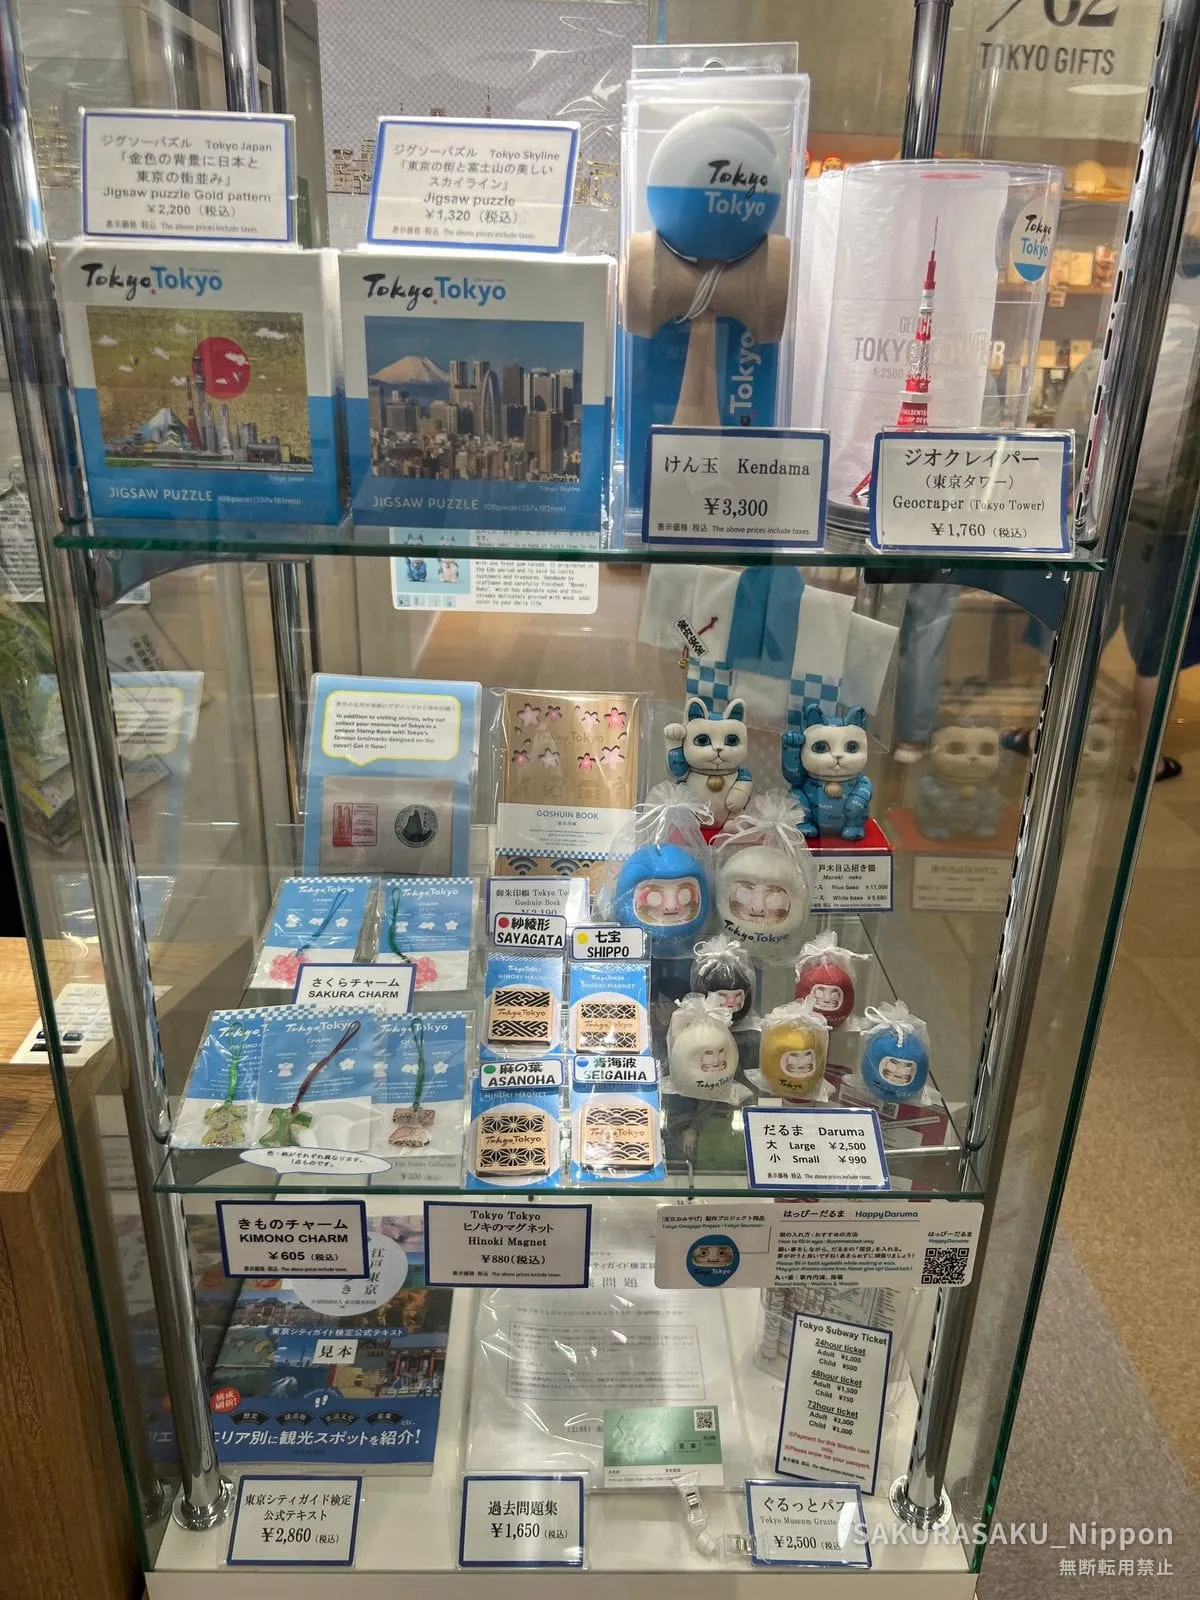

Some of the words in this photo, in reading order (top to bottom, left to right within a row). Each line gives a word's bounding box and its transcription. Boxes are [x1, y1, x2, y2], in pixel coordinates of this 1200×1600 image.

[980, 42, 1048, 71] TOKYO
[1054, 48, 1115, 75] GIFTS
[102, 134, 192, 150] ジグソーパズル
[206, 140, 237, 152] Tokyo
[240, 142, 271, 153] Japan
[394, 145, 476, 157] ジグソーパズル
[490, 150, 520, 160] Tokyo
[524, 151, 560, 161] Skyline
[121, 152, 258, 169] 「金色の背景に日本と
[400, 161, 553, 174] 「東京の街と富士山の美しい
[137, 171, 231, 186] 東京の街並み」
[430, 177, 508, 191] スカイライン」
[708, 160, 768, 198] Tokyo
[104, 187, 146, 199] Jigsaw
[151, 189, 190, 202] puzzle
[195, 190, 223, 201] Gold
[228, 193, 270, 203] pattern
[424, 192, 470, 205] Jigsaw
[474, 195, 515, 208] puzzle
[147, 204, 190, 215] ¥2,200
[705, 191, 766, 221] Tokyo
[425, 210, 470, 223] ¥1,320
[1021, 237, 1048, 260] Tokyo
[81, 263, 150, 300] Tokyo
[151, 267, 223, 296] Tokyo
[363, 274, 434, 311] Tokyo
[434, 276, 506, 306] Tokyo
[730, 331, 761, 414] Tokyo
[905, 449, 1039, 467] ジオクレイパー
[665, 456, 719, 474] けん玉
[738, 458, 810, 475] Kendama
[110, 487, 158, 500] JIGSAW
[163, 489, 213, 501] PUZZLE
[373, 497, 423, 508] JIGSAW
[429, 499, 479, 510] PUZZLE
[704, 498, 768, 519] ¥3,300
[893, 496, 964, 511] Geocraper
[1009, 499, 1045, 511] Tower)
[658, 523, 688, 532] 表示価格
[693, 524, 707, 532] 税込
[750, 527, 765, 535] prices
[932, 523, 985, 537] ¥1,760
[537, 810, 574, 818] GOSHUIN
[816, 864, 875, 872] 戸木目込招き猫
[429, 888, 458, 897] Tokyo
[596, 931, 620, 943] 七宝
[724, 919, 754, 942] Tokyo
[755, 932, 789, 943] Tokyo
[497, 932, 562, 946] SAYAGATA
[588, 947, 629, 957] SHIPPO
[313, 978, 400, 987] さくらチャーム
[308, 990, 354, 998] SAKURA
[500, 1062, 543, 1073] 麻の葉
[594, 1057, 637, 1068] 青海波
[488, 1075, 555, 1086] ASANOHA
[584, 1071, 647, 1080] SEIGAIHA
[764, 1125, 803, 1136] だるま
[819, 1127, 865, 1137] Daruma
[767, 1140, 777, 1150] 大
[789, 1142, 815, 1151] Large
[829, 1142, 866, 1151] ¥2,500
[770, 1154, 780, 1162] 小
[793, 1155, 820, 1163] Small
[839, 1155, 866, 1164] ¥990
[471, 1210, 503, 1220] Tokyo
[509, 1211, 540, 1220] Tokyo
[238, 1218, 348, 1230] きものチャーム
[464, 1223, 553, 1233] ヒノキのマグネット
[240, 1234, 294, 1243] KIMONO
[298, 1234, 348, 1243] CHARM
[468, 1237, 503, 1245] Hinoki
[508, 1238, 546, 1246] Magnet
[269, 1252, 304, 1261] ¥605
[799, 1320, 823, 1332] Tokyo
[826, 1325, 859, 1340] Subway
[862, 1332, 887, 1345] Ticket
[320, 1345, 352, 1358] 見本
[815, 1338, 842, 1350] 24hour
[844, 1344, 865, 1355] ticket
[817, 1349, 835, 1358] Adult
[819, 1358, 836, 1367] Child
[811, 1369, 838, 1382] 48hour
[841, 1376, 862, 1387] ticket
[813, 1380, 830, 1389] Adult
[815, 1390, 832, 1398] Child
[807, 1401, 834, 1413] 72hour
[837, 1407, 858, 1418] ticket
[810, 1411, 827, 1420] Adult
[809, 1420, 826, 1430] Child
[245, 1494, 351, 1506] 東京シティガイド検定
[488, 1501, 558, 1516] 過去問題集
[264, 1510, 327, 1521] 公式テキスト
[760, 1516, 781, 1524] Tokyo
[784, 1517, 812, 1525] Museum
[262, 1528, 311, 1544] ¥2,860
[491, 1522, 540, 1540] ¥1,650
[774, 1536, 816, 1548] ¥2,500
